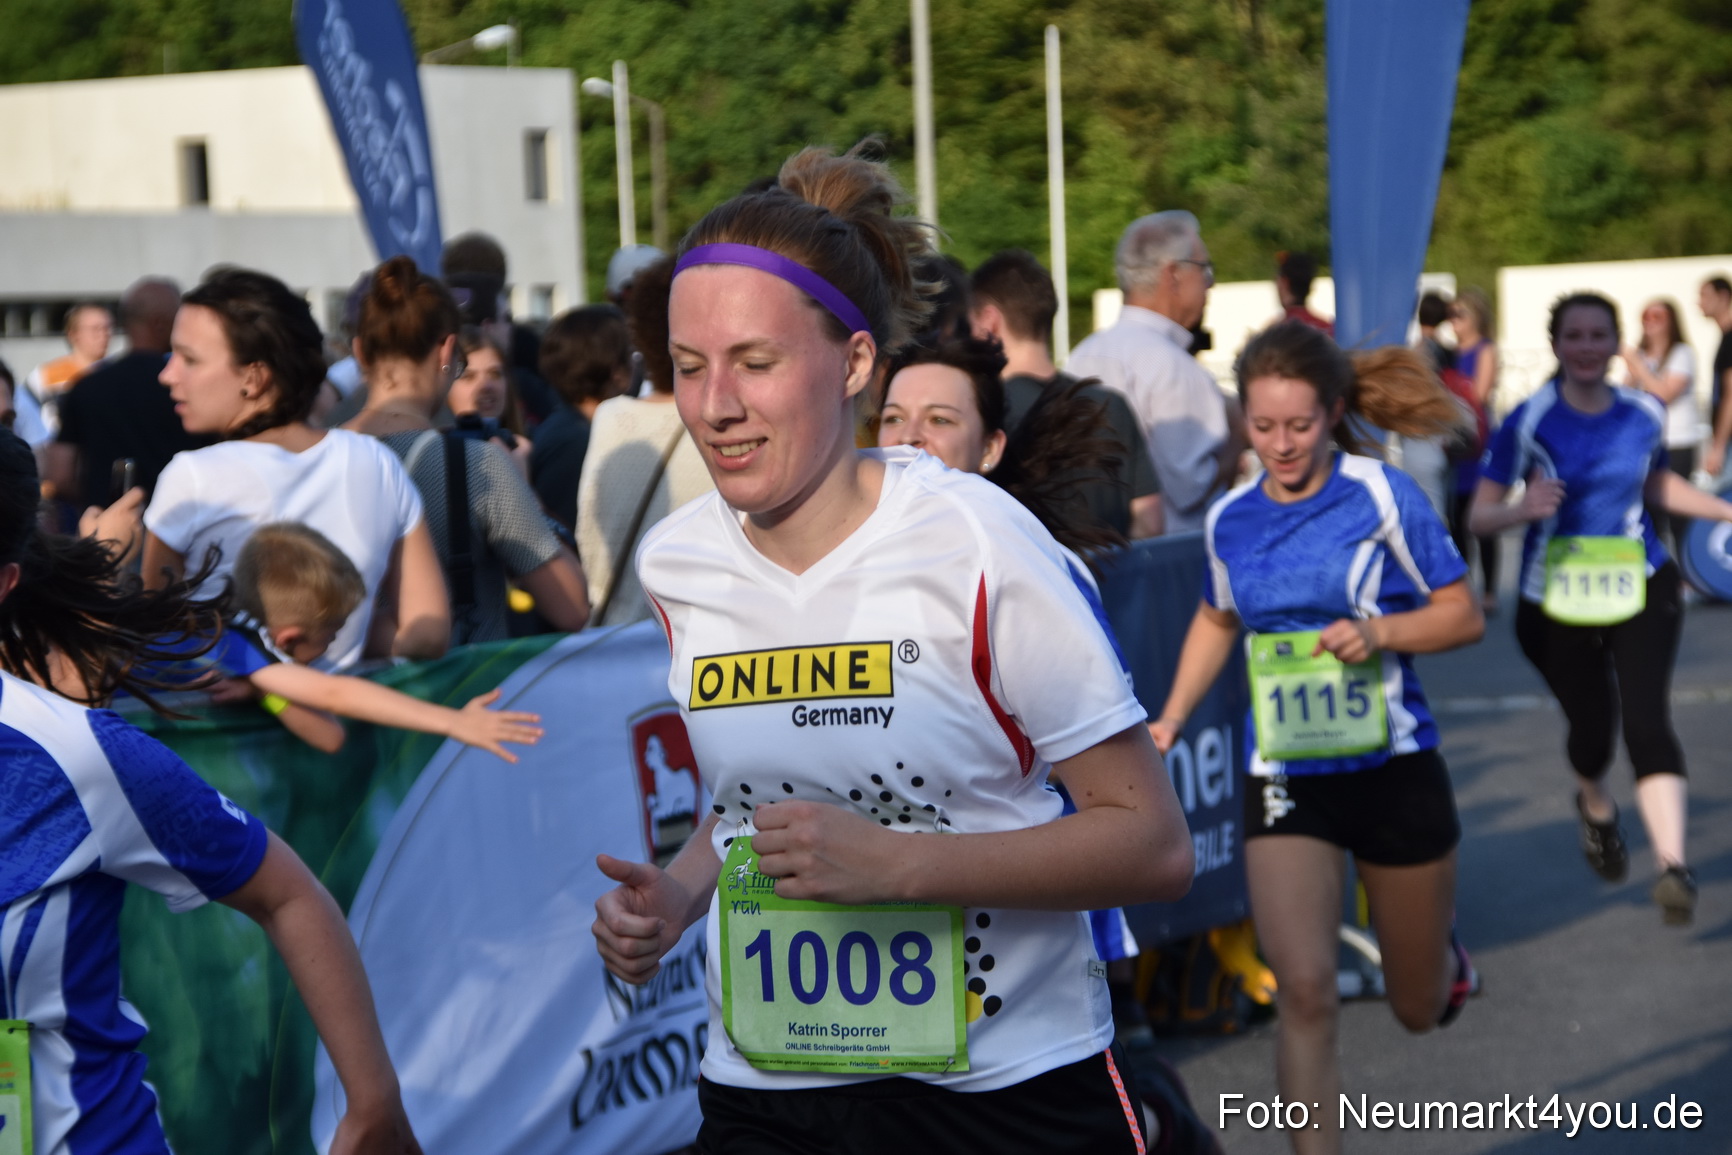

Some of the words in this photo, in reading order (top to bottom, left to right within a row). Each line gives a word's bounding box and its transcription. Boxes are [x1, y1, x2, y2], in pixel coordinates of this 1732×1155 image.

[698, 650, 871, 702] ONLINE
[792, 704, 895, 728] Germany
[1269, 680, 1371, 723] 1115
[745, 929, 936, 1006] 1008
[785, 1042, 812, 1051] ONLINE
[813, 1043, 864, 1053] Schreibgeräte
[788, 1022, 828, 1036] Katrin
[831, 1023, 887, 1040] Sporrer
